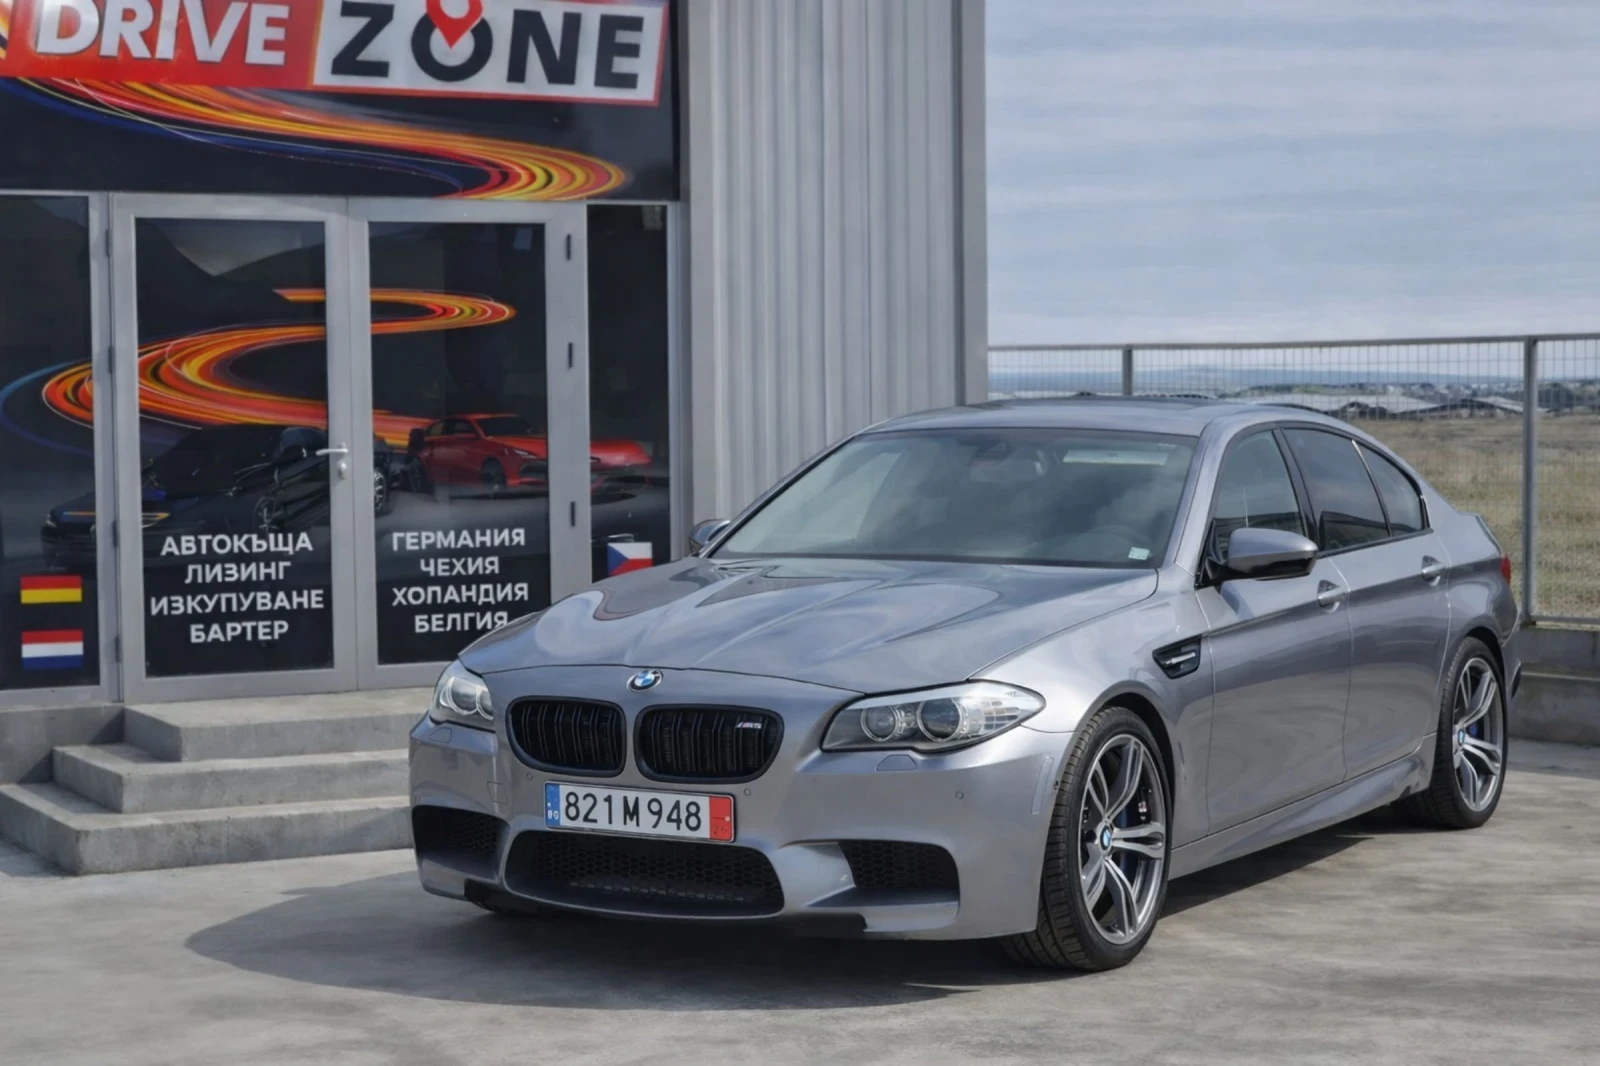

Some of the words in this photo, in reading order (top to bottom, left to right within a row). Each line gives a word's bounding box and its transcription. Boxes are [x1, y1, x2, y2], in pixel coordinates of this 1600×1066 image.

[36, 0, 290, 65] DRIVE
[331, 0, 644, 89] ZONE
[160, 532, 314, 556] АВТОКЪЩА
[392, 528, 526, 551] ГЕРМАНИЯ
[184, 561, 292, 584] ЛИЗИНГ
[420, 556, 500, 577] ЧЕХИЯ
[151, 589, 325, 616] ИЗКУПУВАНЕ
[189, 620, 289, 643] БАРТЕР
[414, 611, 509, 633] БЕЛГИЯ
